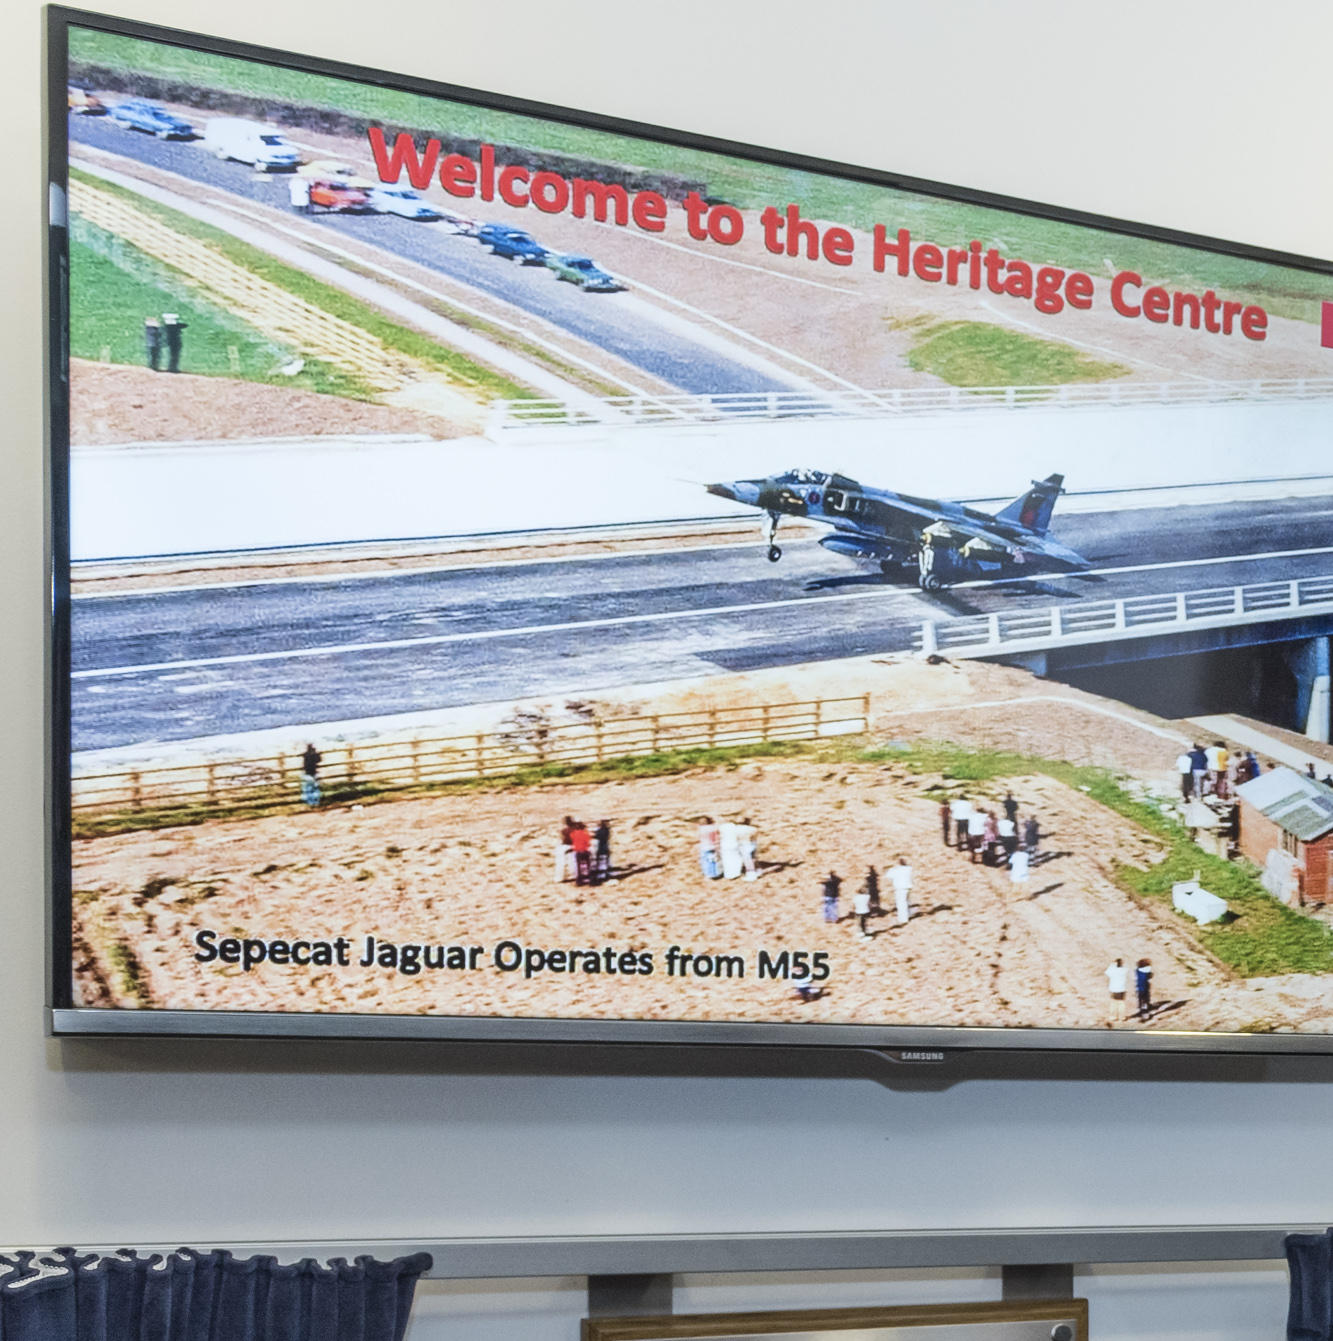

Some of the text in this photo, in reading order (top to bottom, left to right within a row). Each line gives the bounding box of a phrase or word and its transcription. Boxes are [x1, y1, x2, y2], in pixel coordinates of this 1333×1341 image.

[368, 127, 1269, 341] Welcome to the Heritage Centre
[195, 930, 831, 981] Sepecat Jaguar Operates from M55
[902, 1052, 944, 1060] SAMSUNG
